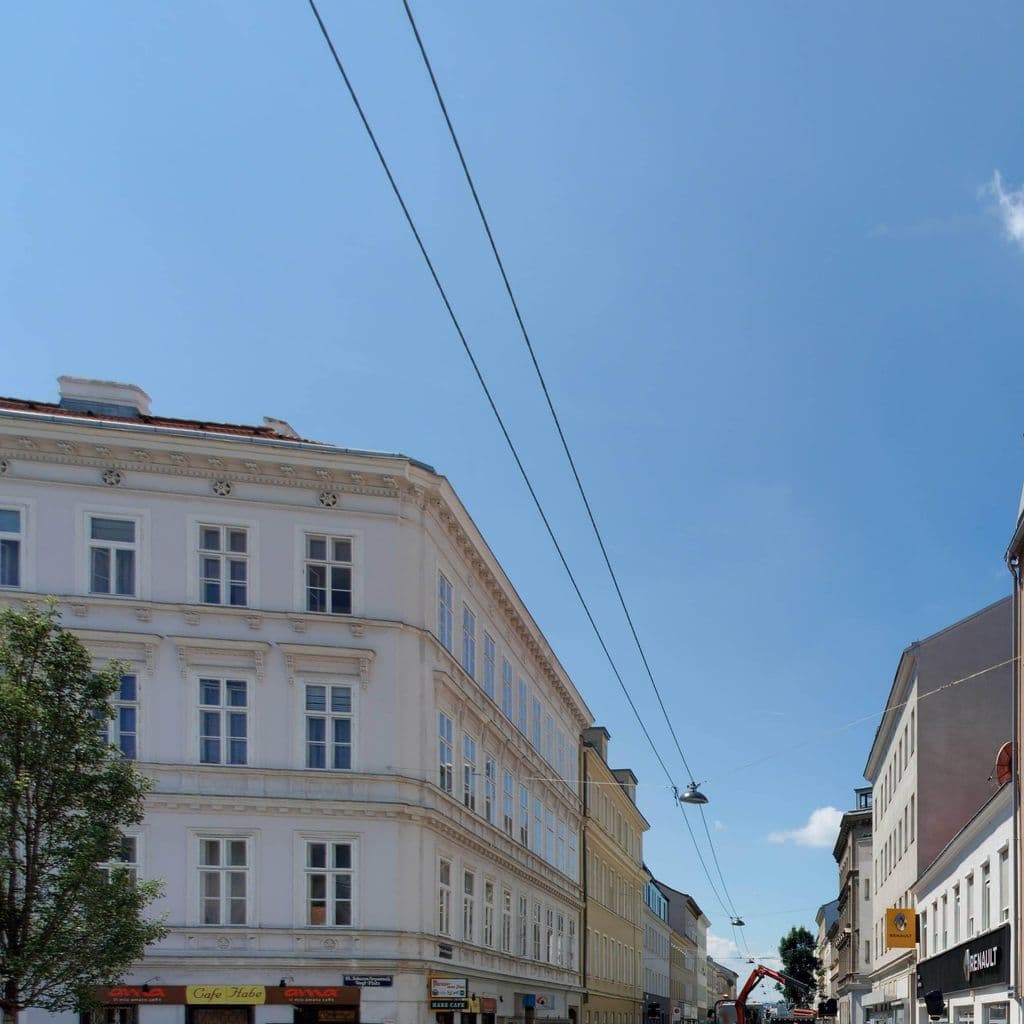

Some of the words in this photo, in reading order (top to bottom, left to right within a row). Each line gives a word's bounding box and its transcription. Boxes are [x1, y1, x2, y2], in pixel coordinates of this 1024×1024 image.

[969, 945, 998, 972] RENAULT
[193, 987, 222, 1001] Cafe
[226, 986, 263, 999] Habe
